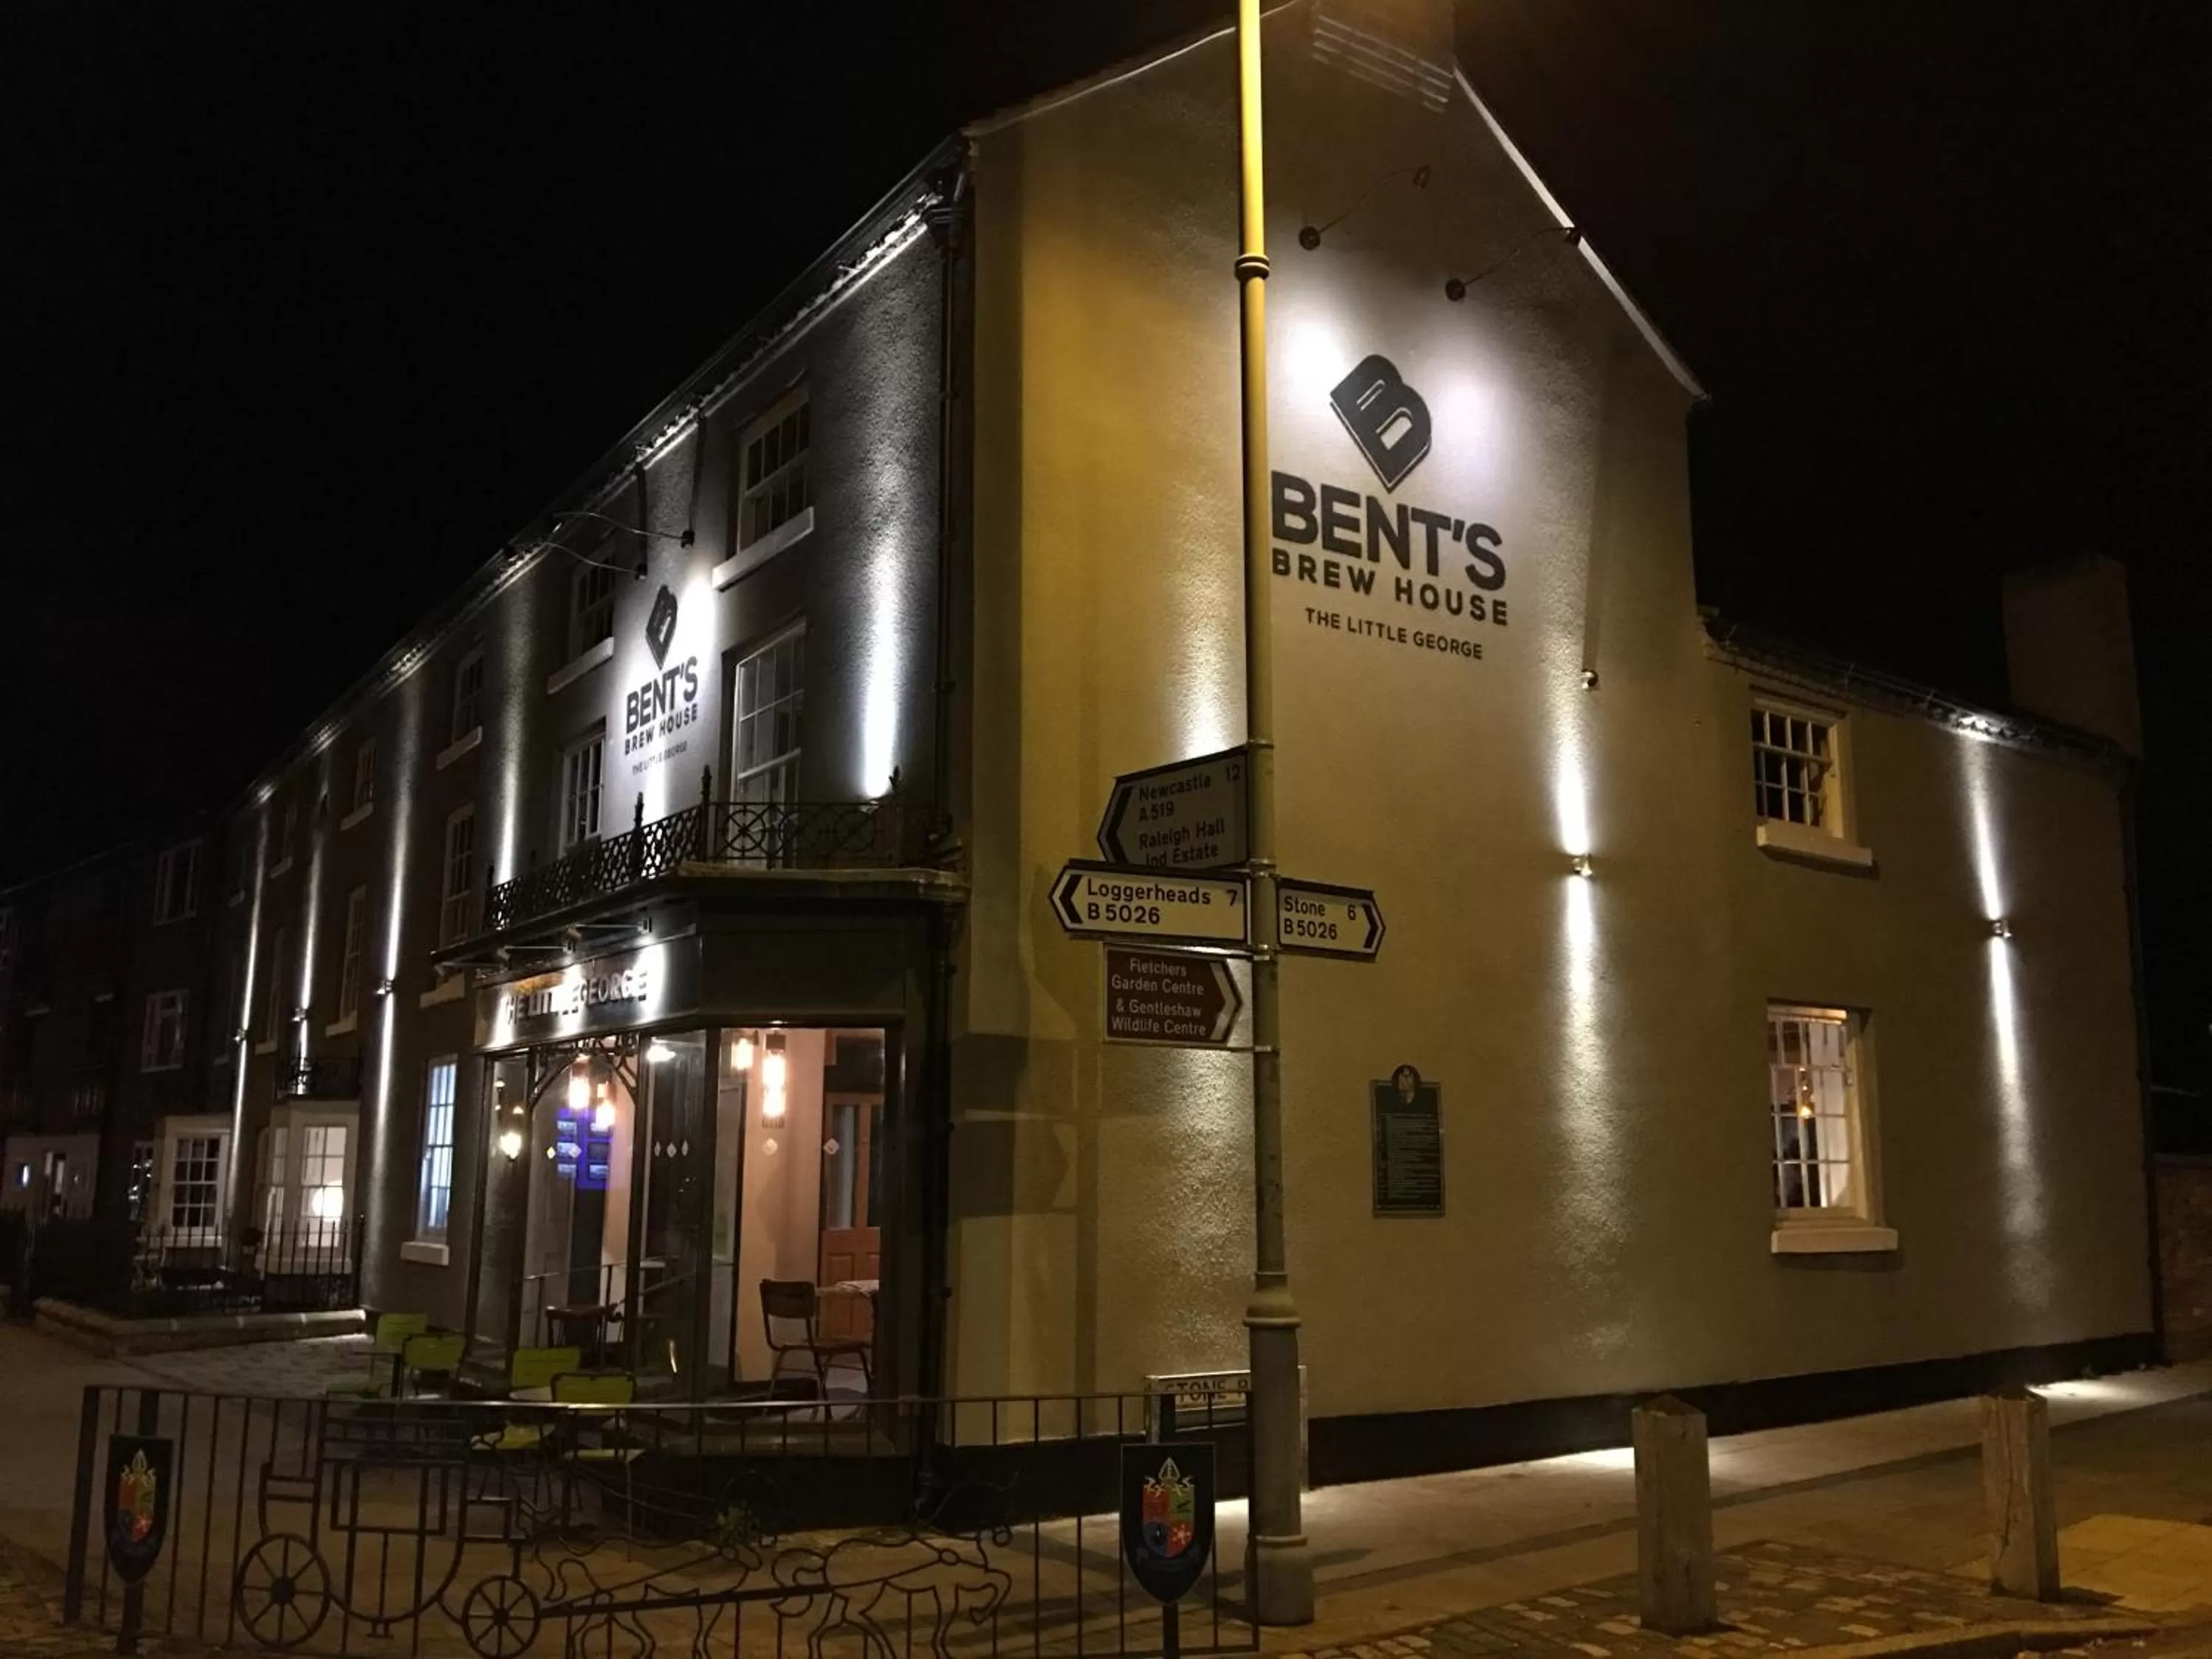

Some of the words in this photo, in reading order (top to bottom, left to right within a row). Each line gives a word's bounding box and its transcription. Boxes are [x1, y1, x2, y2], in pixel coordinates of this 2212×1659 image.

[1271, 469, 1506, 591] BENT'S
[1271, 548, 1376, 596] BREW
[1394, 577, 1508, 627] HOUSE
[1305, 607, 1341, 629] THE
[1348, 616, 1408, 644] LITTLE
[1413, 631, 1483, 660] GEORGE
[626, 655, 698, 734] BENT'S
[625, 726, 655, 756] BREW
[659, 703, 698, 737] HOUSE
[1138, 773, 1211, 801] Newcastle
[1225, 764, 1241, 782] 12
[1139, 825, 1190, 849] Raleigh
[1196, 818, 1225, 838] Hall
[1145, 851, 1166, 868] Ind
[1173, 844, 1219, 863] Estate
[1088, 878, 1211, 905] Loggerheads
[1226, 888, 1238, 906] 7
[1284, 896, 1326, 917] Stone
[1347, 904, 1357, 921] 6
[1129, 957, 1188, 977] Fletchers
[1111, 973, 1158, 991] Garden
[1162, 978, 1204, 995] Centre
[1116, 997, 1125, 1013] &
[1129, 999, 1202, 1018] Gentleshaw
[1111, 1015, 1160, 1033] Wildlife
[1164, 1019, 1207, 1037] Centre
